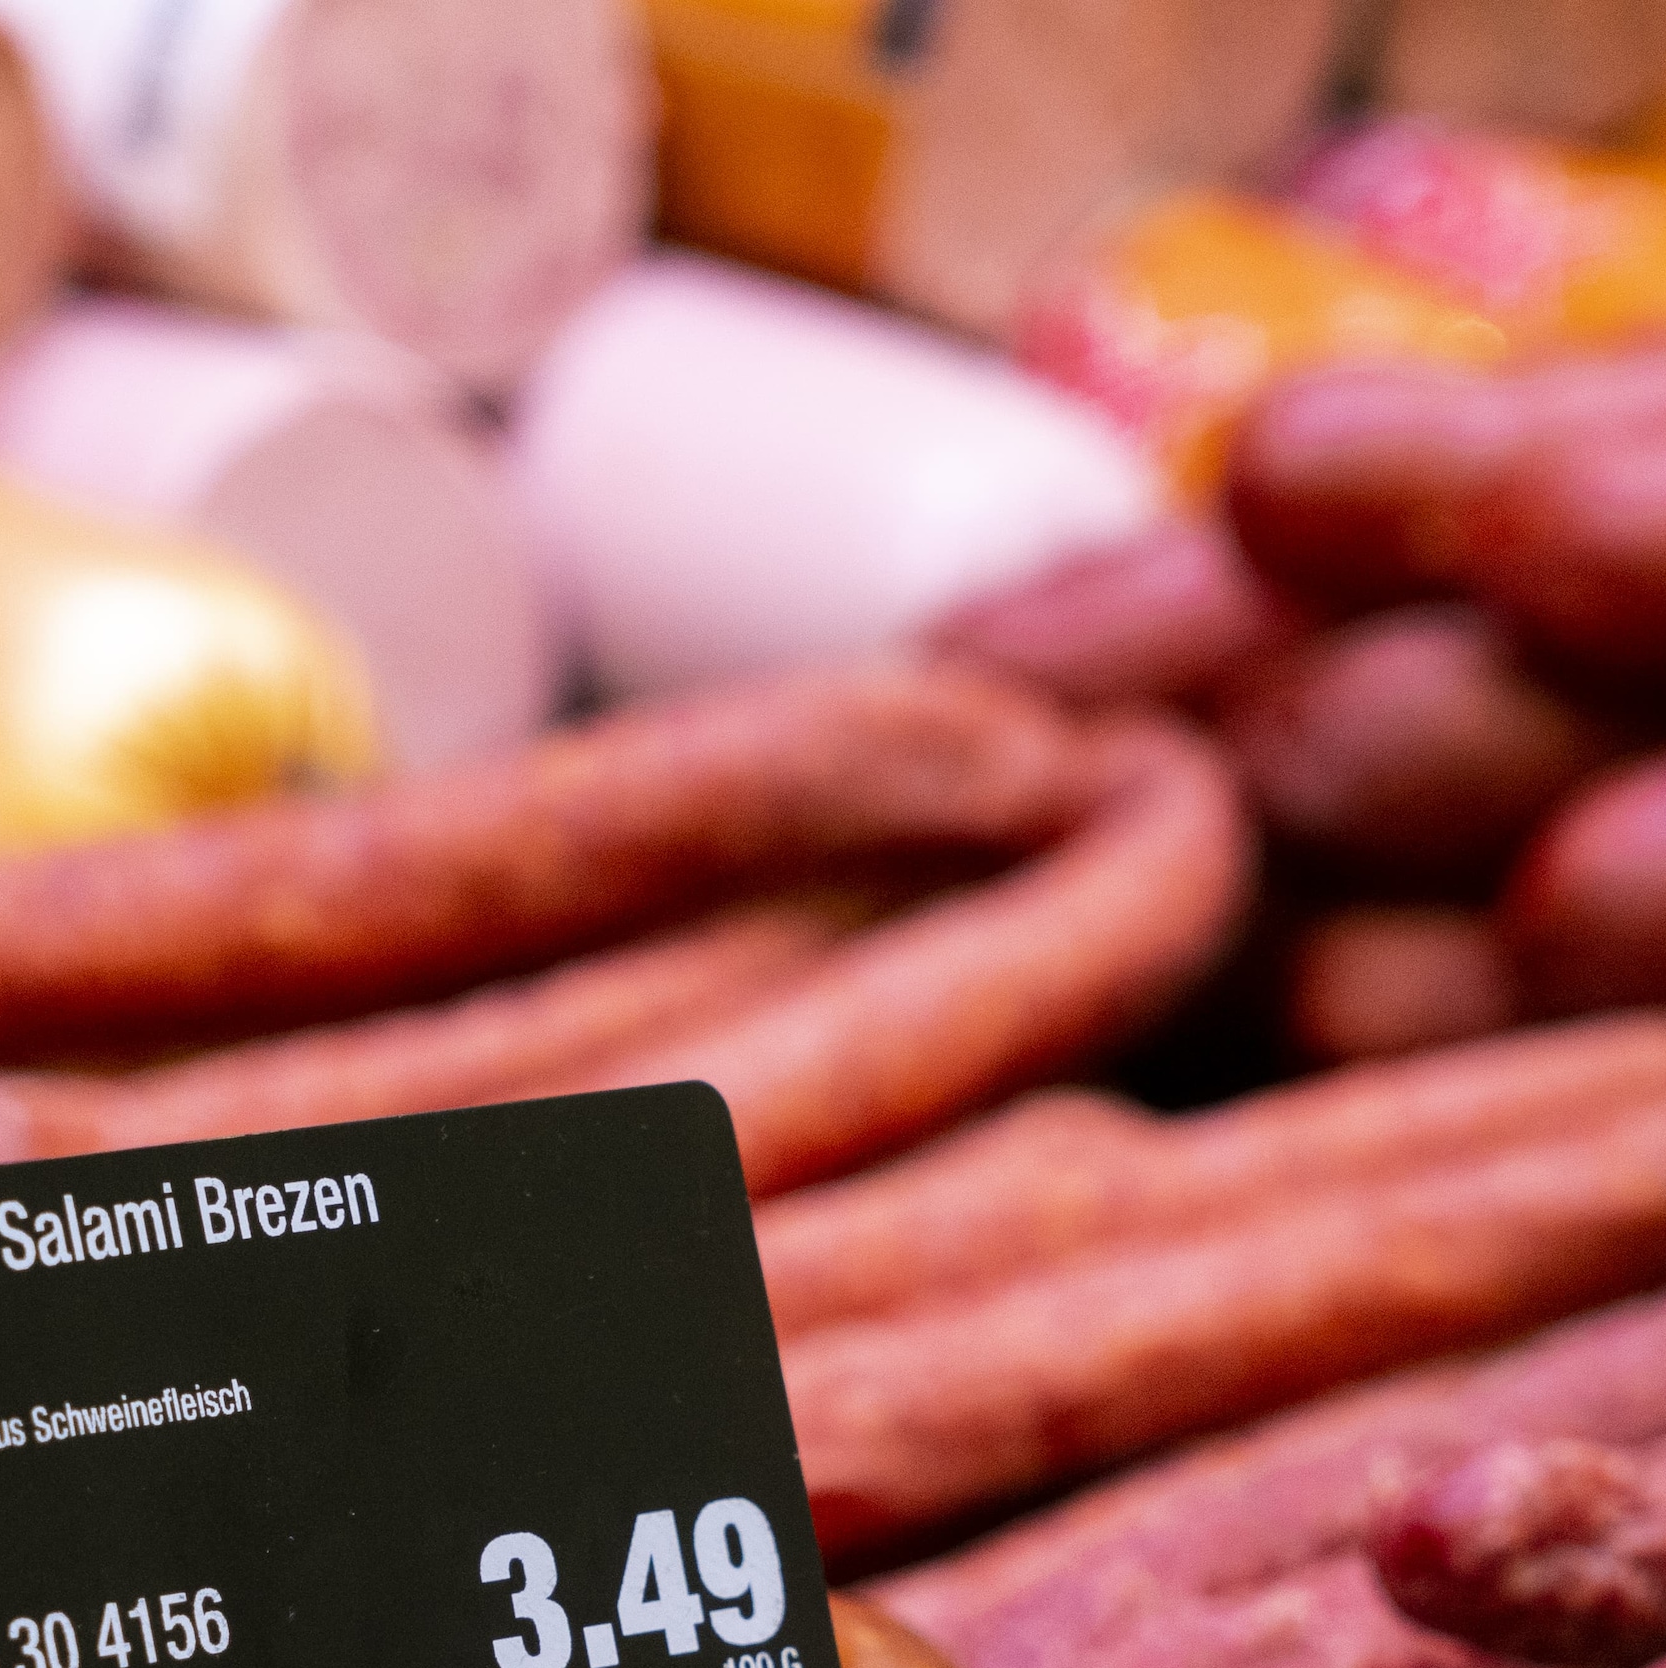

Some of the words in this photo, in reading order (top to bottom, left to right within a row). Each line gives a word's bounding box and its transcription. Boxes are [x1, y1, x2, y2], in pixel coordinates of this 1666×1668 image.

[193, 1172, 380, 1245] Brezen
[30, 1379, 253, 1443] Schweinefleisch
[96, 1587, 231, 1668] 4156
